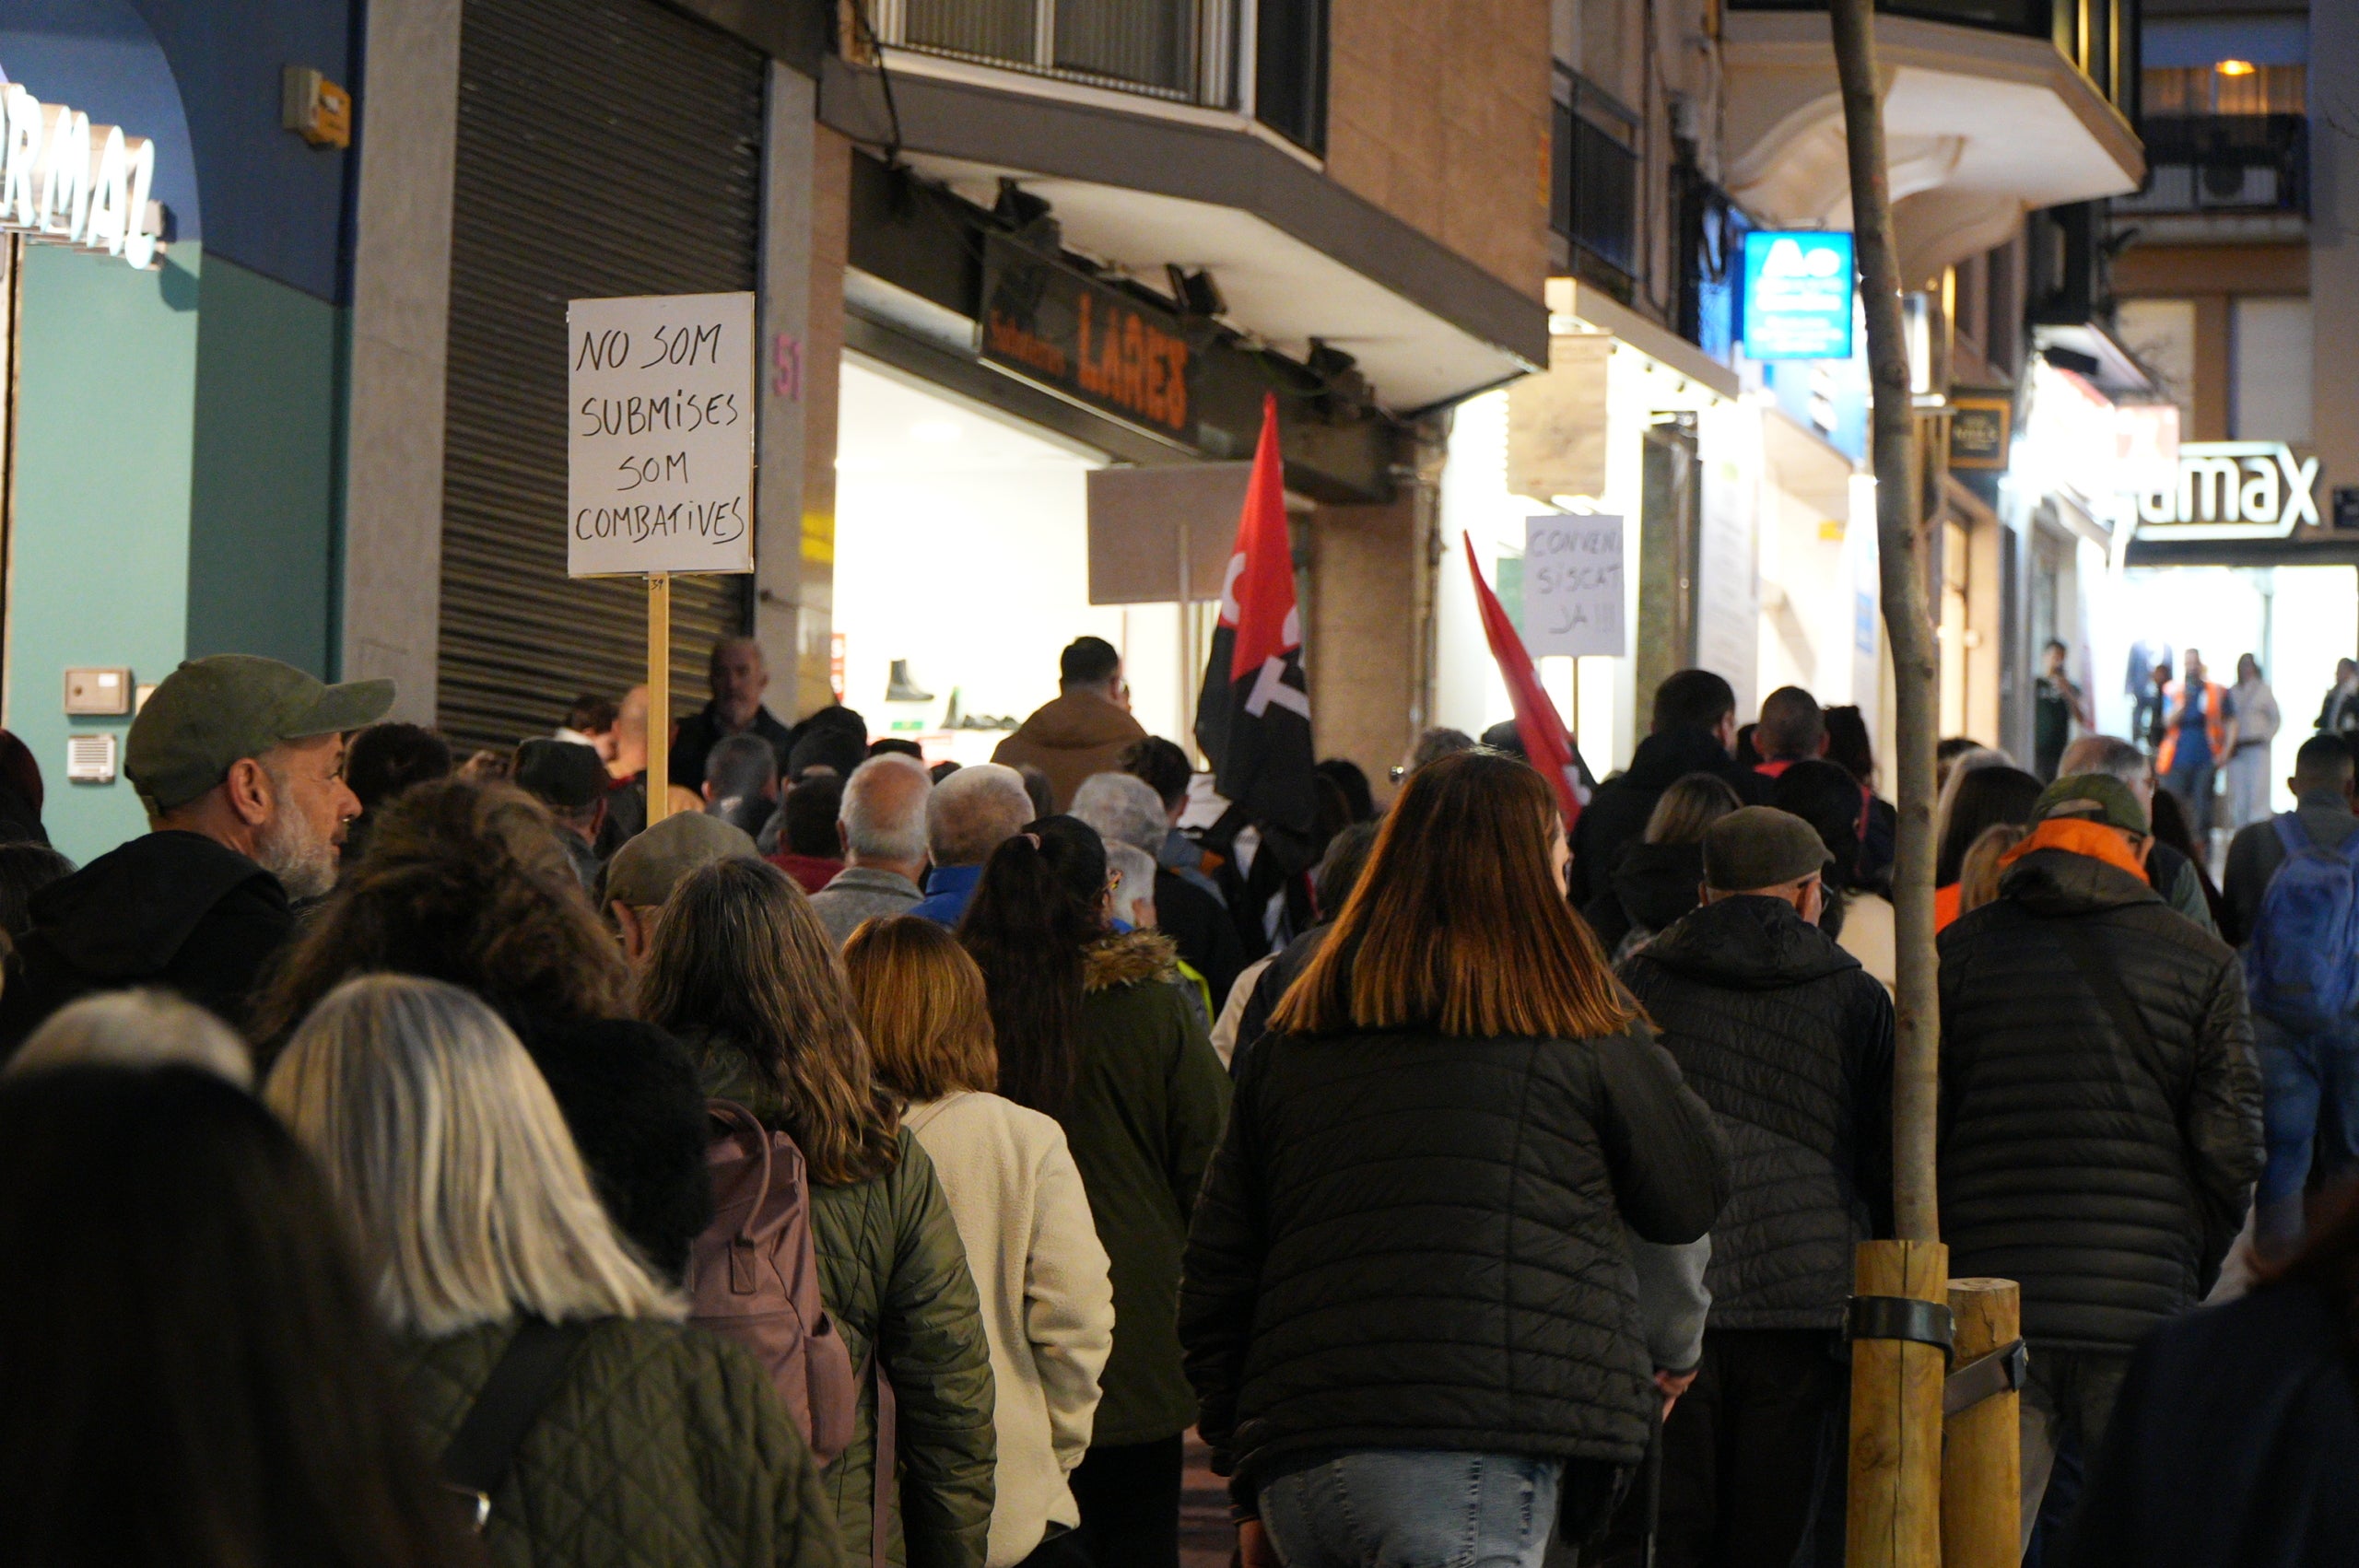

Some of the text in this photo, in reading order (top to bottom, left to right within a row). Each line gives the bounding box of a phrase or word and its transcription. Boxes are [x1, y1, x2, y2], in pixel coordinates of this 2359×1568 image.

[0, 83, 156, 270] RMAL
[575, 323, 722, 371] NO SOM
[616, 451, 689, 492] SOM
